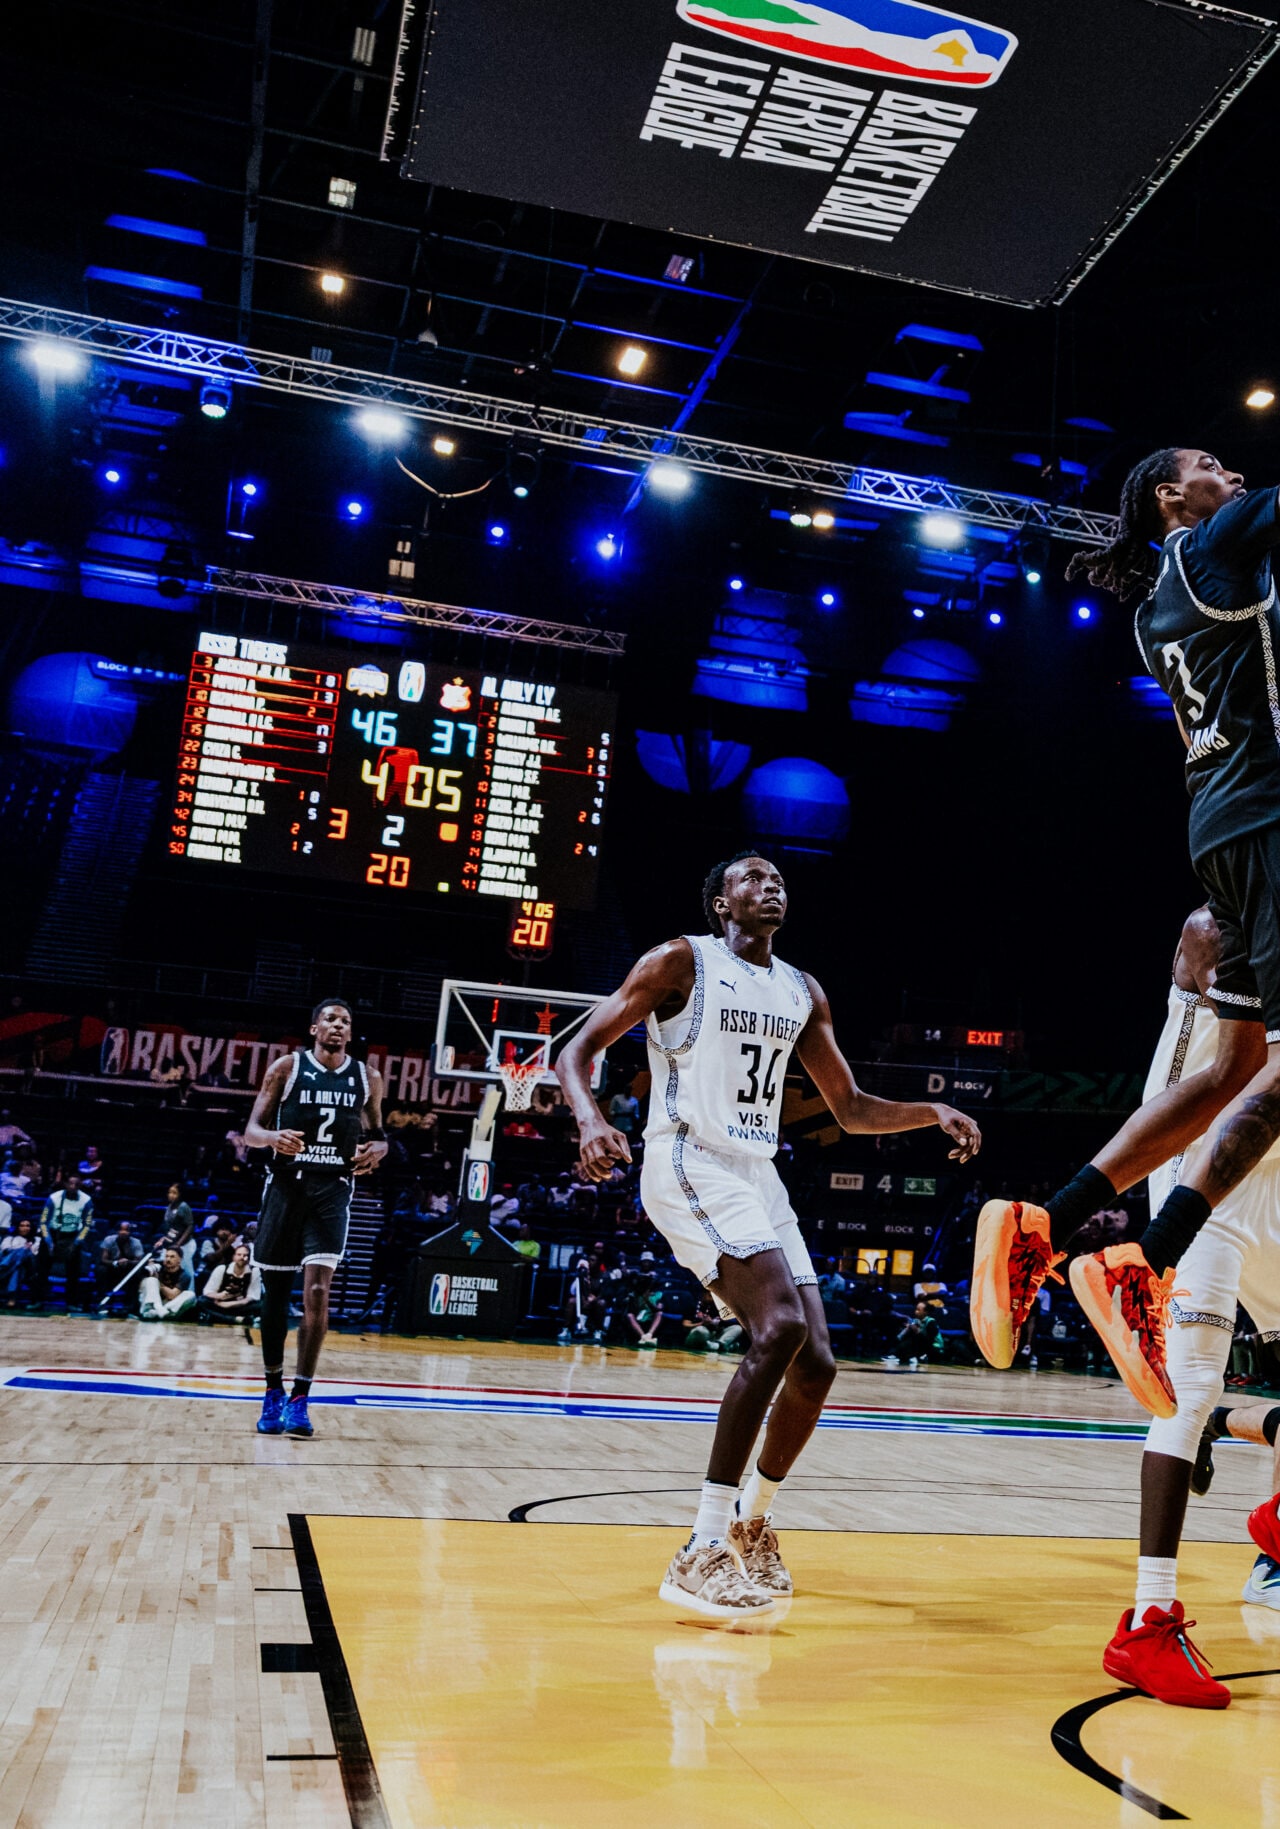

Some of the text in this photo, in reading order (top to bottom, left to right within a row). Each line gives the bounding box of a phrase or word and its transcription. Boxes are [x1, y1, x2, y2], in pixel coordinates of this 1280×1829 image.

[639, 41, 771, 158] LEAGUE
[740, 67, 874, 172] AFRICA
[804, 89, 978, 242] BASKETBALL
[1161, 641, 1206, 722] 3
[352, 708, 398, 747] 46
[430, 719, 477, 758] 37
[317, 741, 327, 754] 3
[327, 808, 405, 847] 3 2
[578, 811, 587, 823] 2
[302, 841, 313, 854] 2
[574, 843, 583, 855] 2
[366, 853, 410, 887] 20
[513, 919, 548, 946] 20
[720, 1009, 757, 1034] RSSB
[967, 1031, 1003, 1046] EXIT
[131, 1030, 306, 1085] BASKET
[737, 1043, 784, 1107] 34
[299, 1090, 356, 1107] AL AHLY LY
[317, 1108, 336, 1143] 2
[294, 1153, 345, 1165] RWANDA
[308, 1145, 337, 1155] VISIT
[877, 1175, 892, 1193] 4
[451, 1276, 498, 1291] BASKETBALL
[450, 1289, 478, 1302] AFRICA
[448, 1302, 478, 1316] LEAGUE
